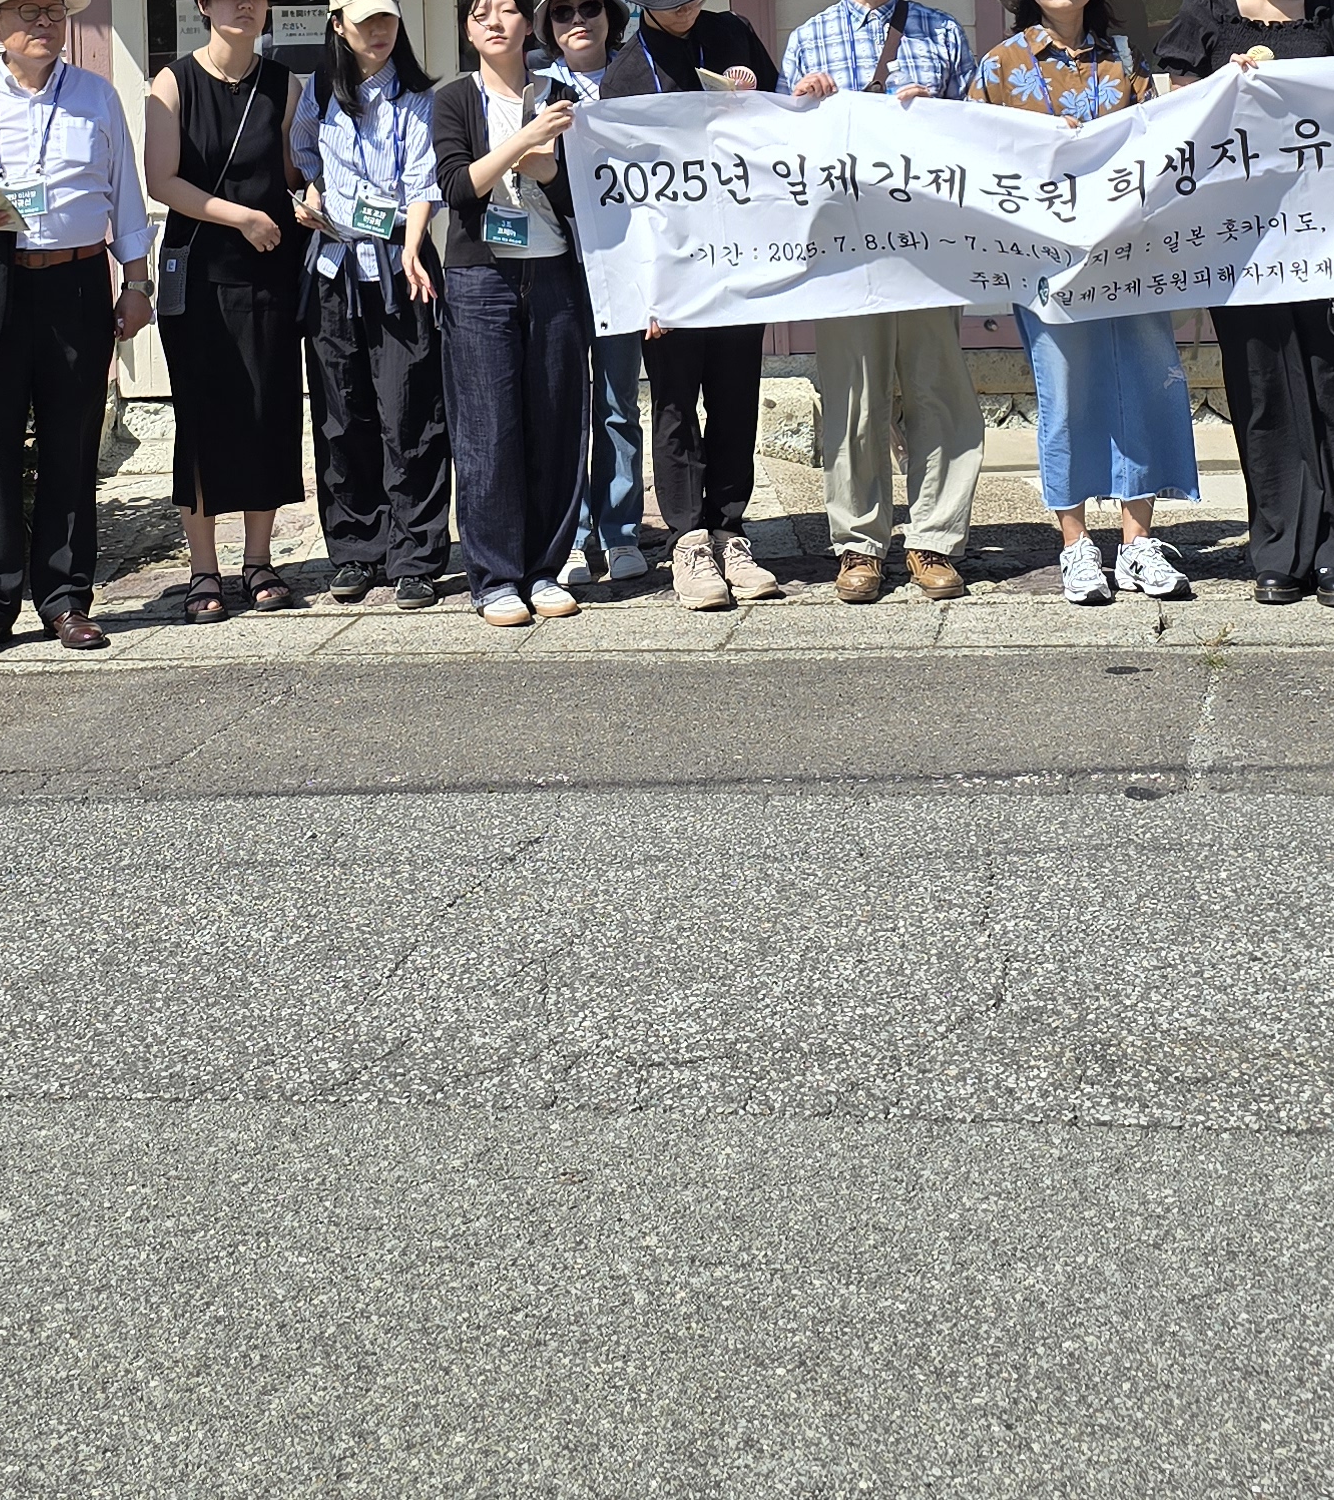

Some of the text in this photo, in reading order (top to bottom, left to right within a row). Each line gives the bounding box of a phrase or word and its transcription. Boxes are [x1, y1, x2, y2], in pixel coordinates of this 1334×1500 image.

[595, 153, 753, 206] 2025년
[772, 153, 1079, 223] 일제강제동원
[1107, 128, 1261, 208] 희생자
[769, 238, 825, 264] 2025.
[1164, 225, 1206, 254] 일본
[1216, 209, 1327, 245] 홋카이도,
[970, 271, 1012, 292] 주최
